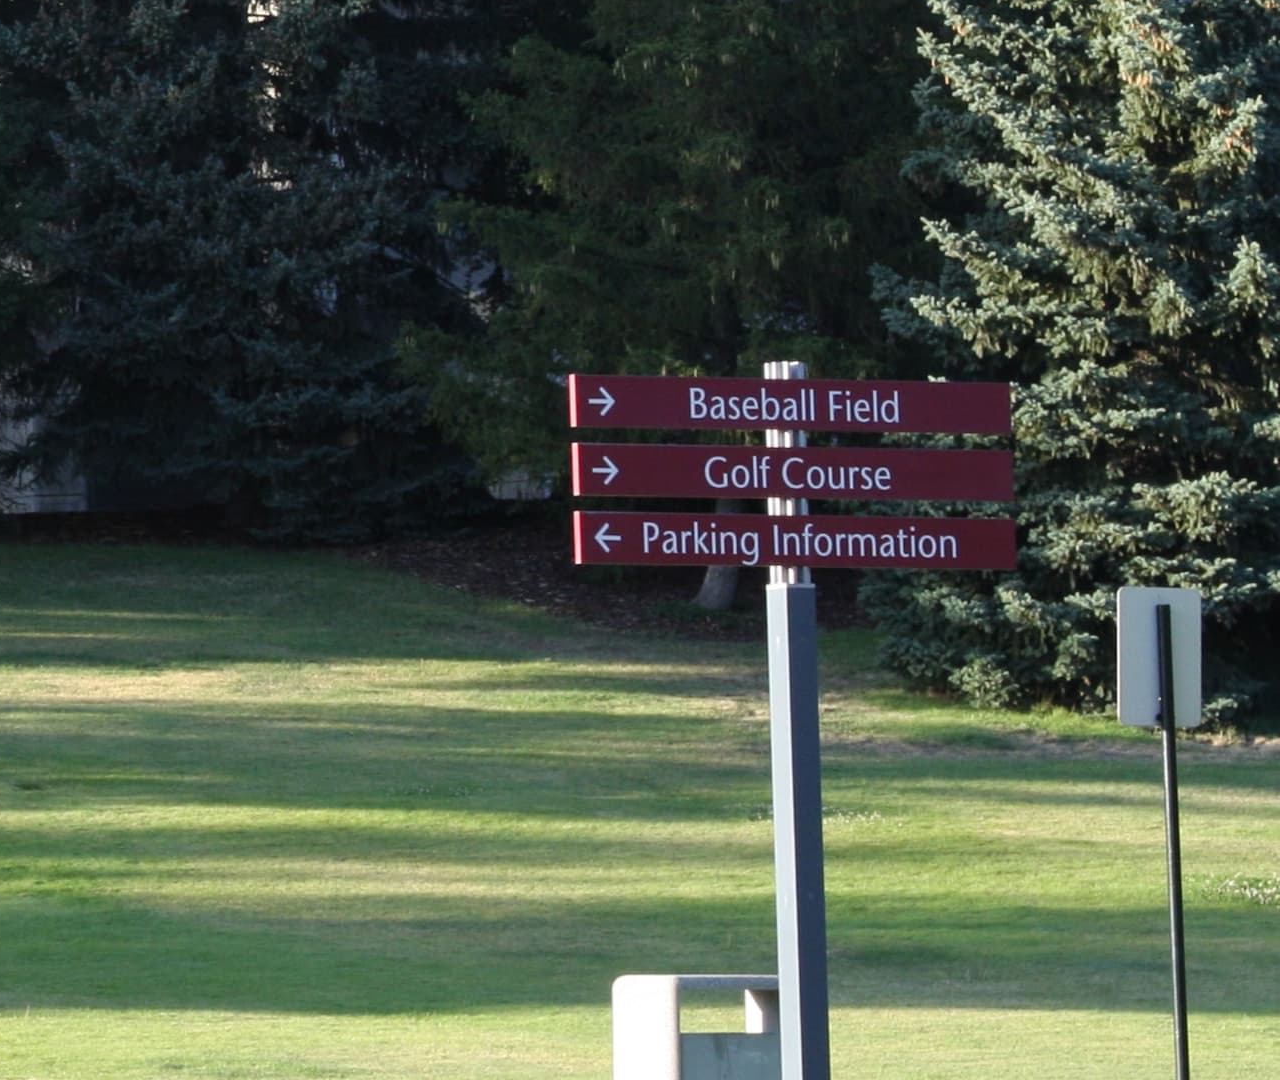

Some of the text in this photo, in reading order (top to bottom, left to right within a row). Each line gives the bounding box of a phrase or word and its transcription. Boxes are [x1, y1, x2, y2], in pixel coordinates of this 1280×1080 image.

[688, 387, 901, 424] Baseball Field
[703, 456, 892, 491] Golf Course
[642, 522, 958, 566] Parking Information
